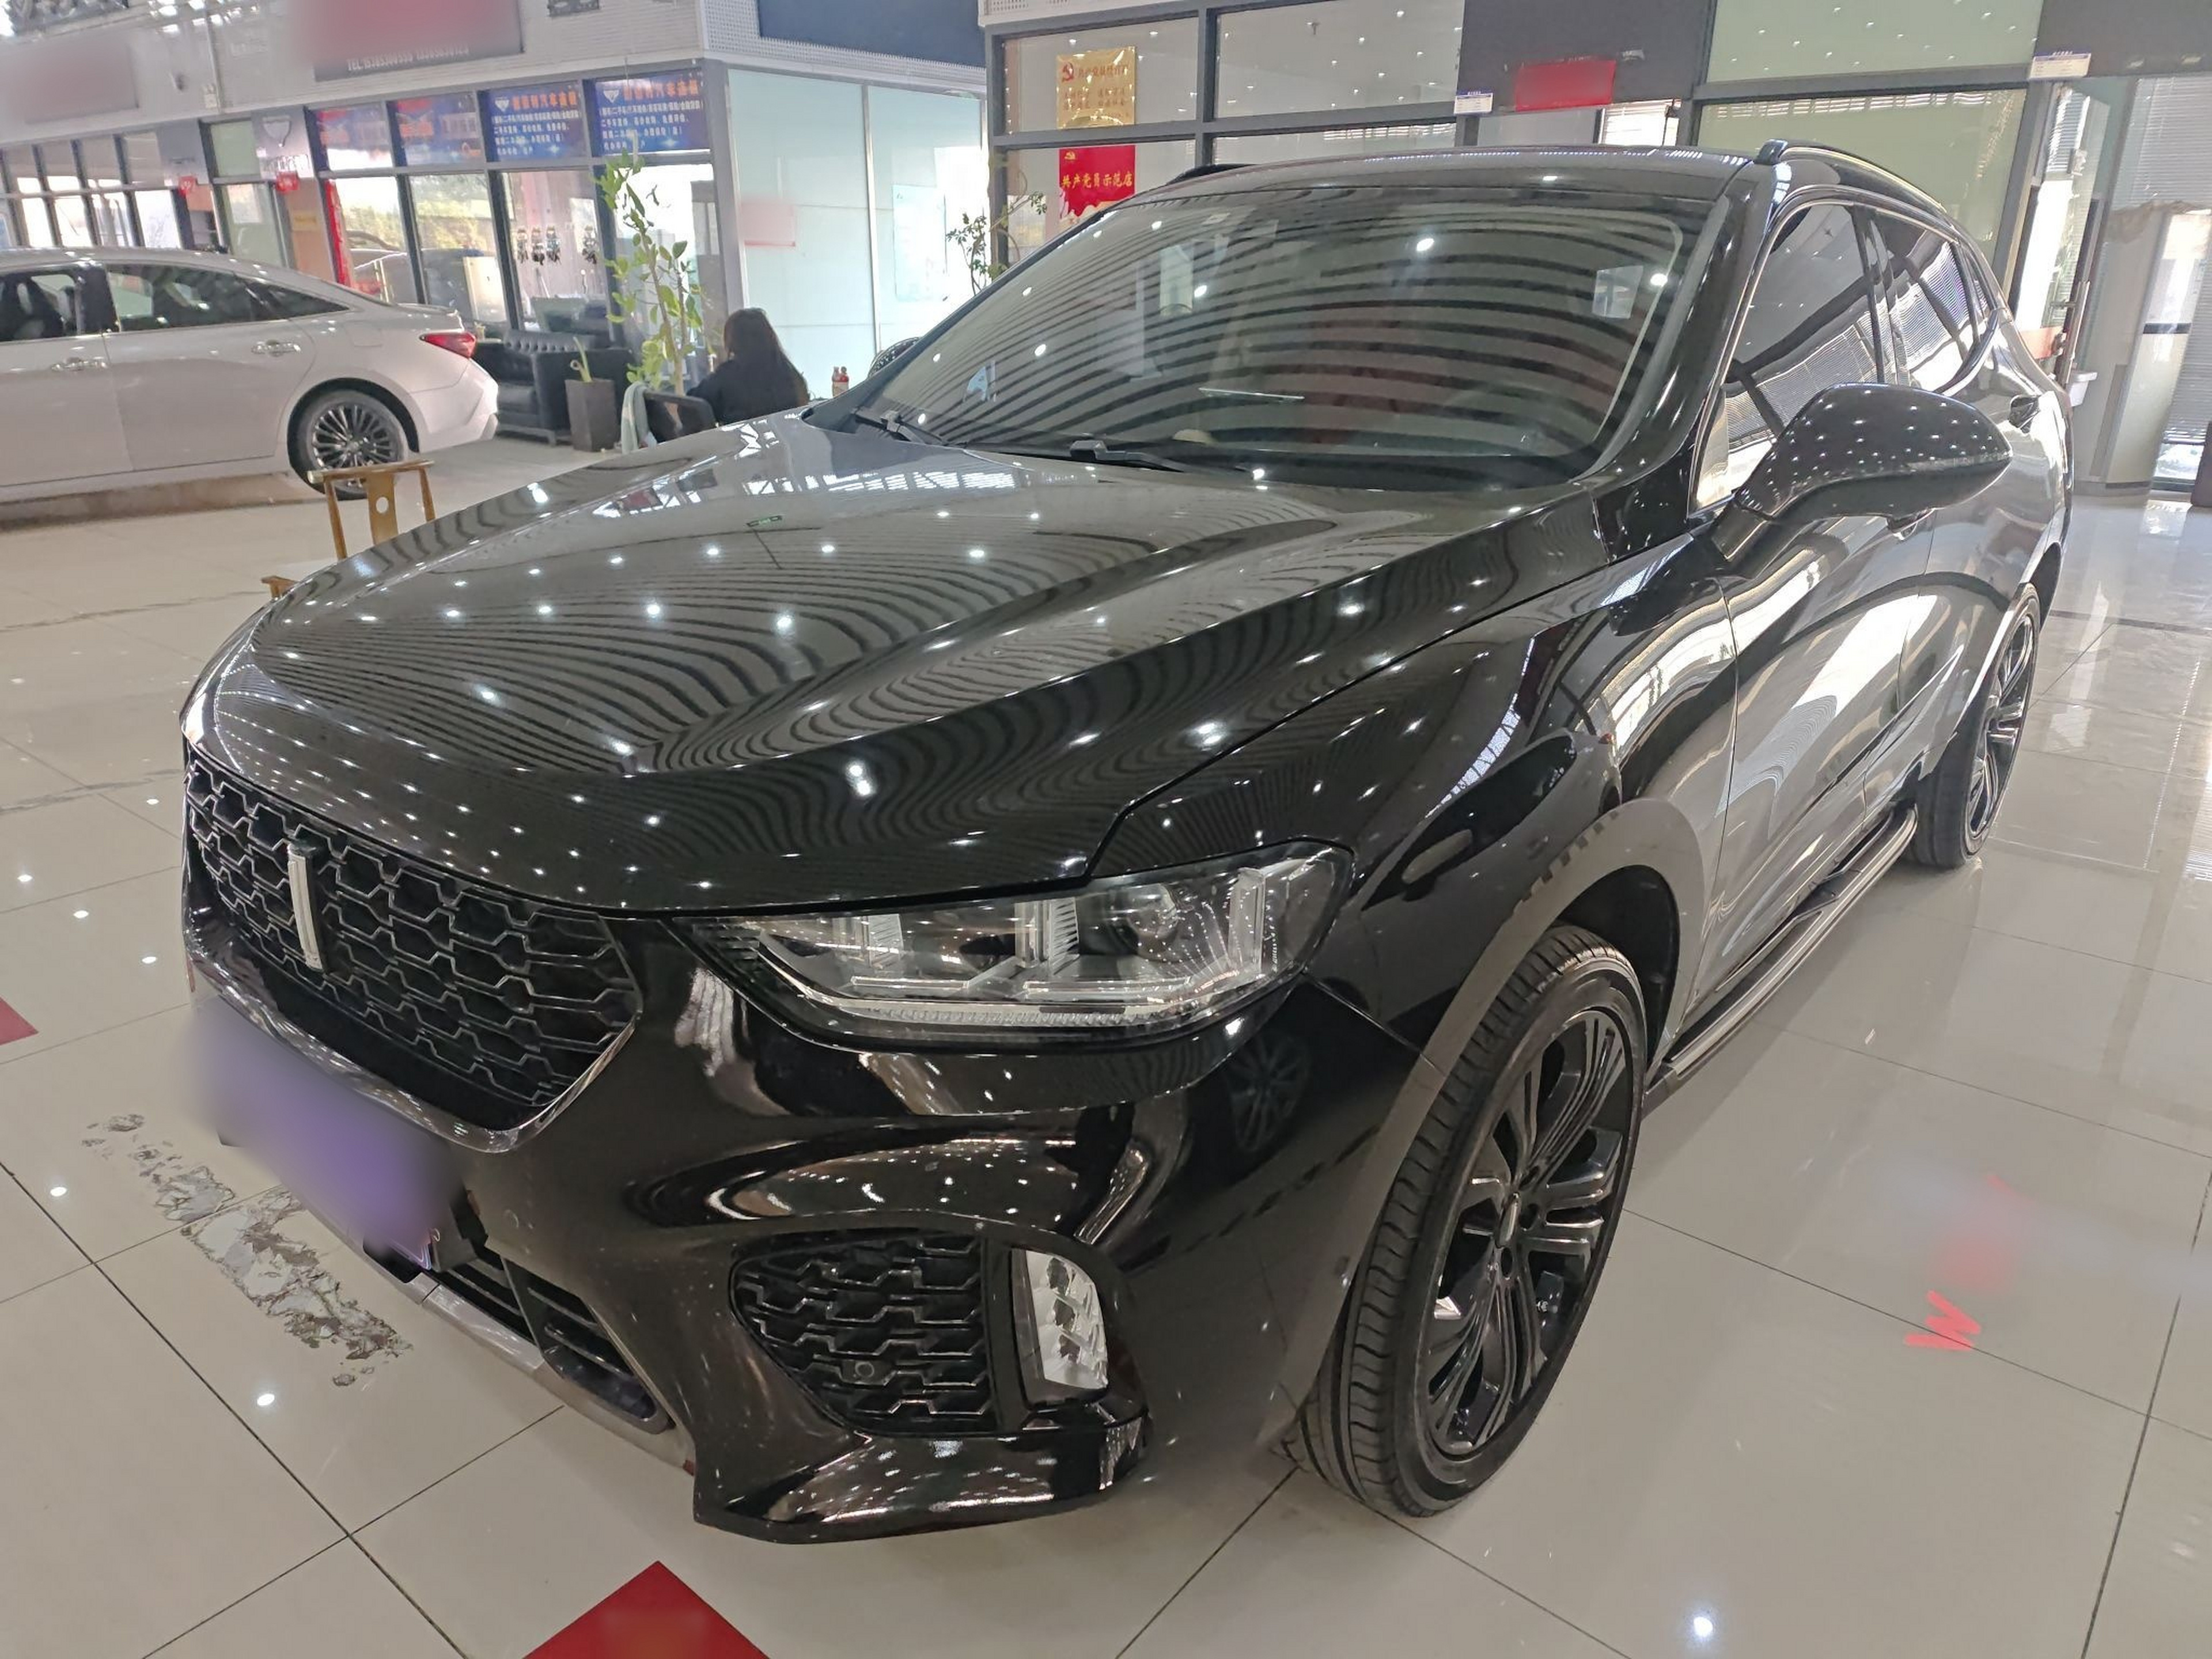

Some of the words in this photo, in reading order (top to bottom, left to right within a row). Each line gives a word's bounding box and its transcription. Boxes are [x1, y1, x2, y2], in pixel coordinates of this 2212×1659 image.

[1062, 171, 1133, 189] 共产党员示范店
